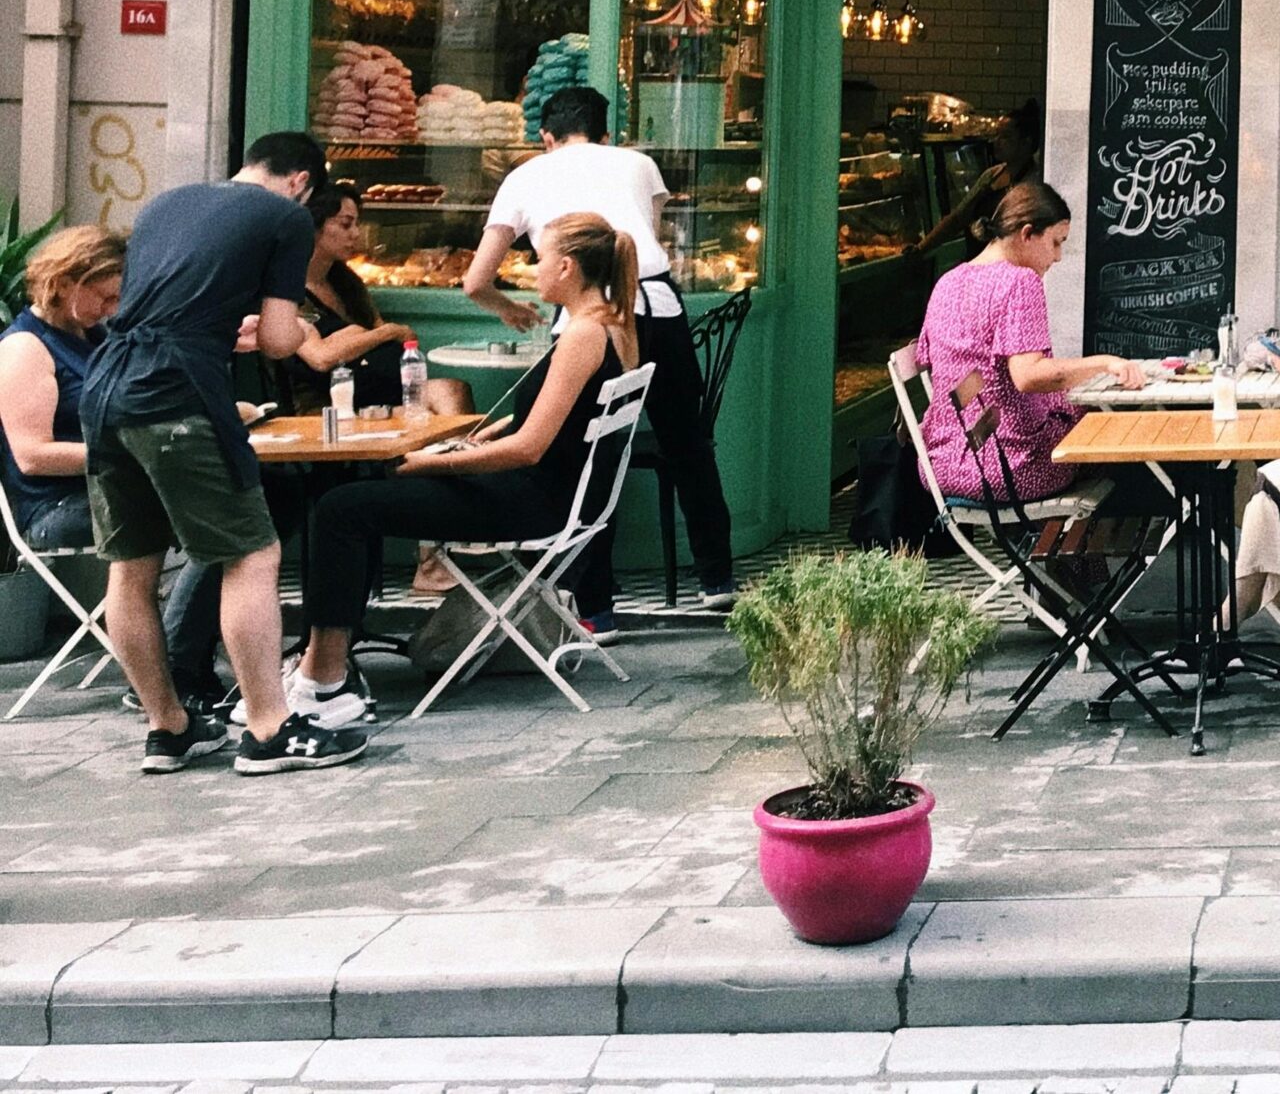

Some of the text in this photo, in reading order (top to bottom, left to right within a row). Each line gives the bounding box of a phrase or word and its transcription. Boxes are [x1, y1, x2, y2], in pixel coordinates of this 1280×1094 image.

[128, 10, 156, 24] 16A
[1152, 61, 1211, 81] pudding
[1154, 111, 1208, 126] cookies
[1117, 150, 1209, 197] Hot
[1107, 180, 1226, 236] Drinks
[1178, 251, 1219, 273] TEA
[1165, 282, 1218, 305] COFFEE
